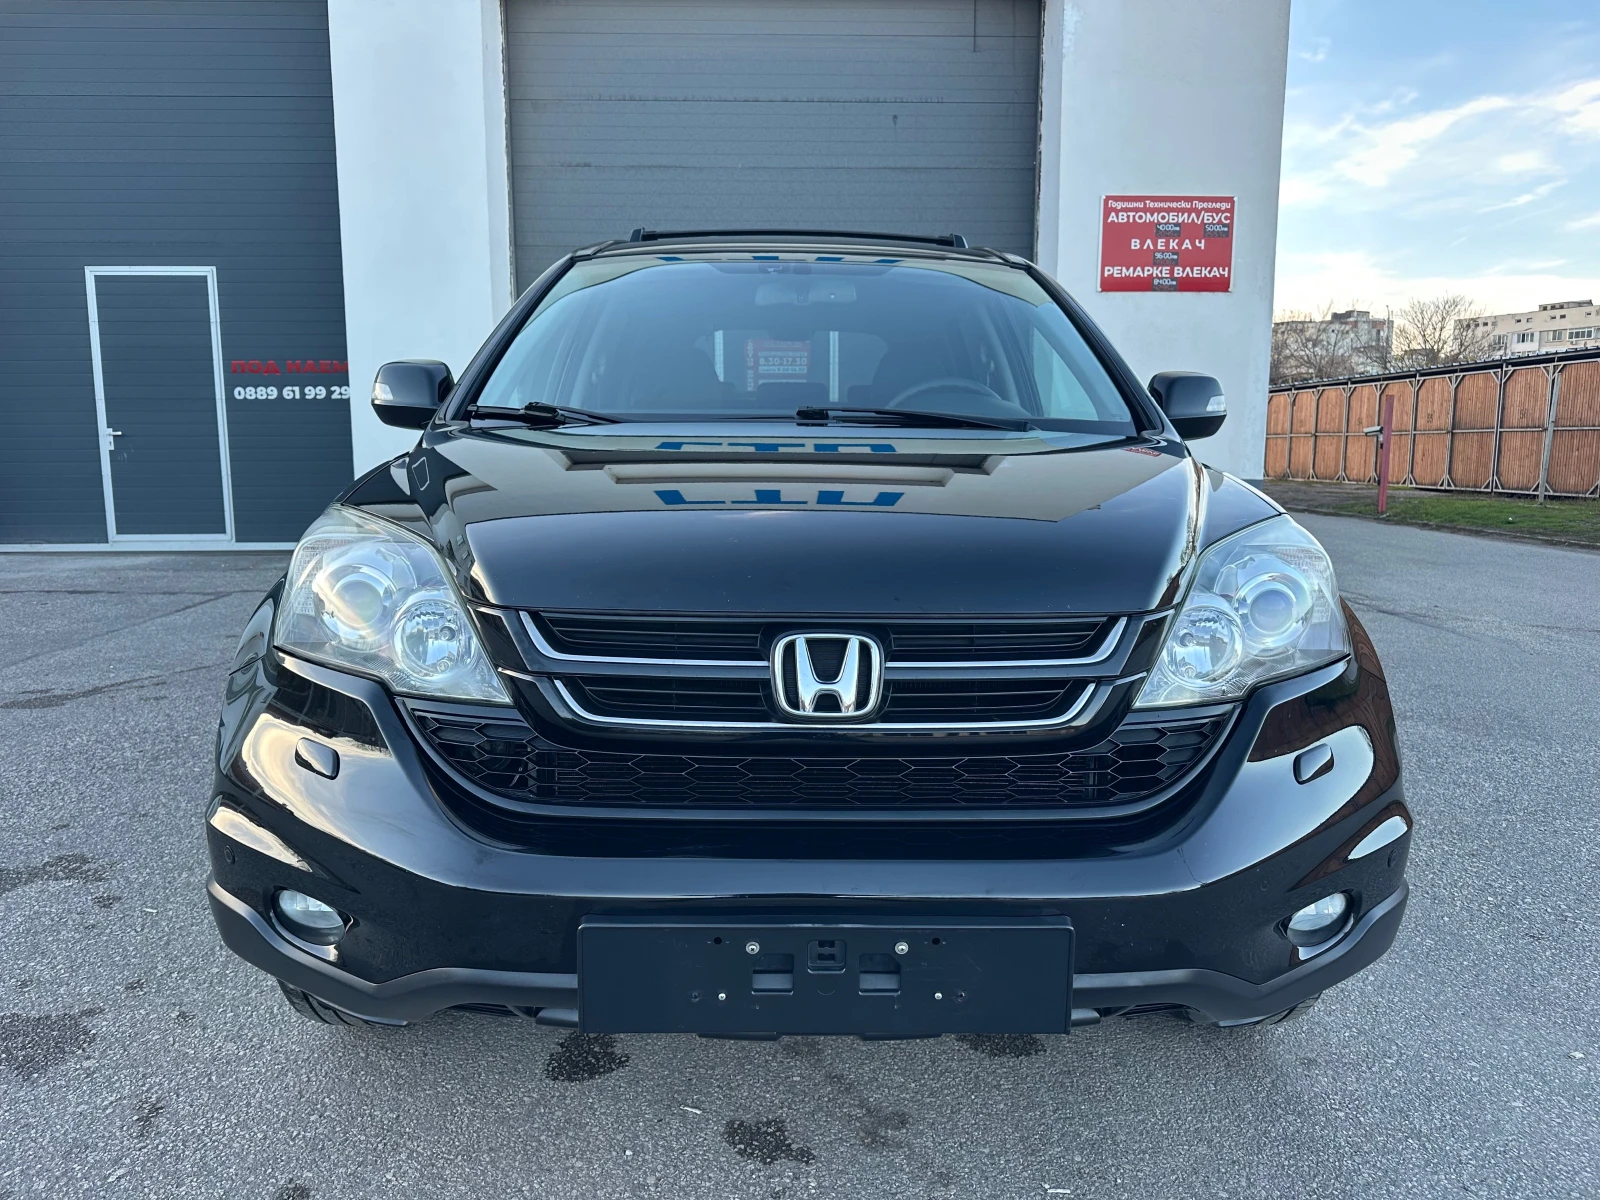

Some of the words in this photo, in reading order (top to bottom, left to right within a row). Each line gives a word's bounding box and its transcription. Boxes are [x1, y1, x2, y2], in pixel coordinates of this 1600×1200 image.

[1108, 200, 1144, 209] Годишни
[1145, 200, 1191, 209] Технически
[1193, 200, 1231, 210] Прегледи
[1107, 211, 1231, 224] АВТОМОБИЛ/БУС
[1104, 266, 1170, 278] РЕМАРКЕ
[1174, 267, 1229, 278] ВЛЕКАЧ
[231, 360, 281, 375] ПОД
[286, 360, 349, 374] НАЕМ
[233, 386, 278, 400] 0889
[282, 386, 300, 400] 61
[304, 386, 327, 400] 99
[330, 386, 350, 400] 29
